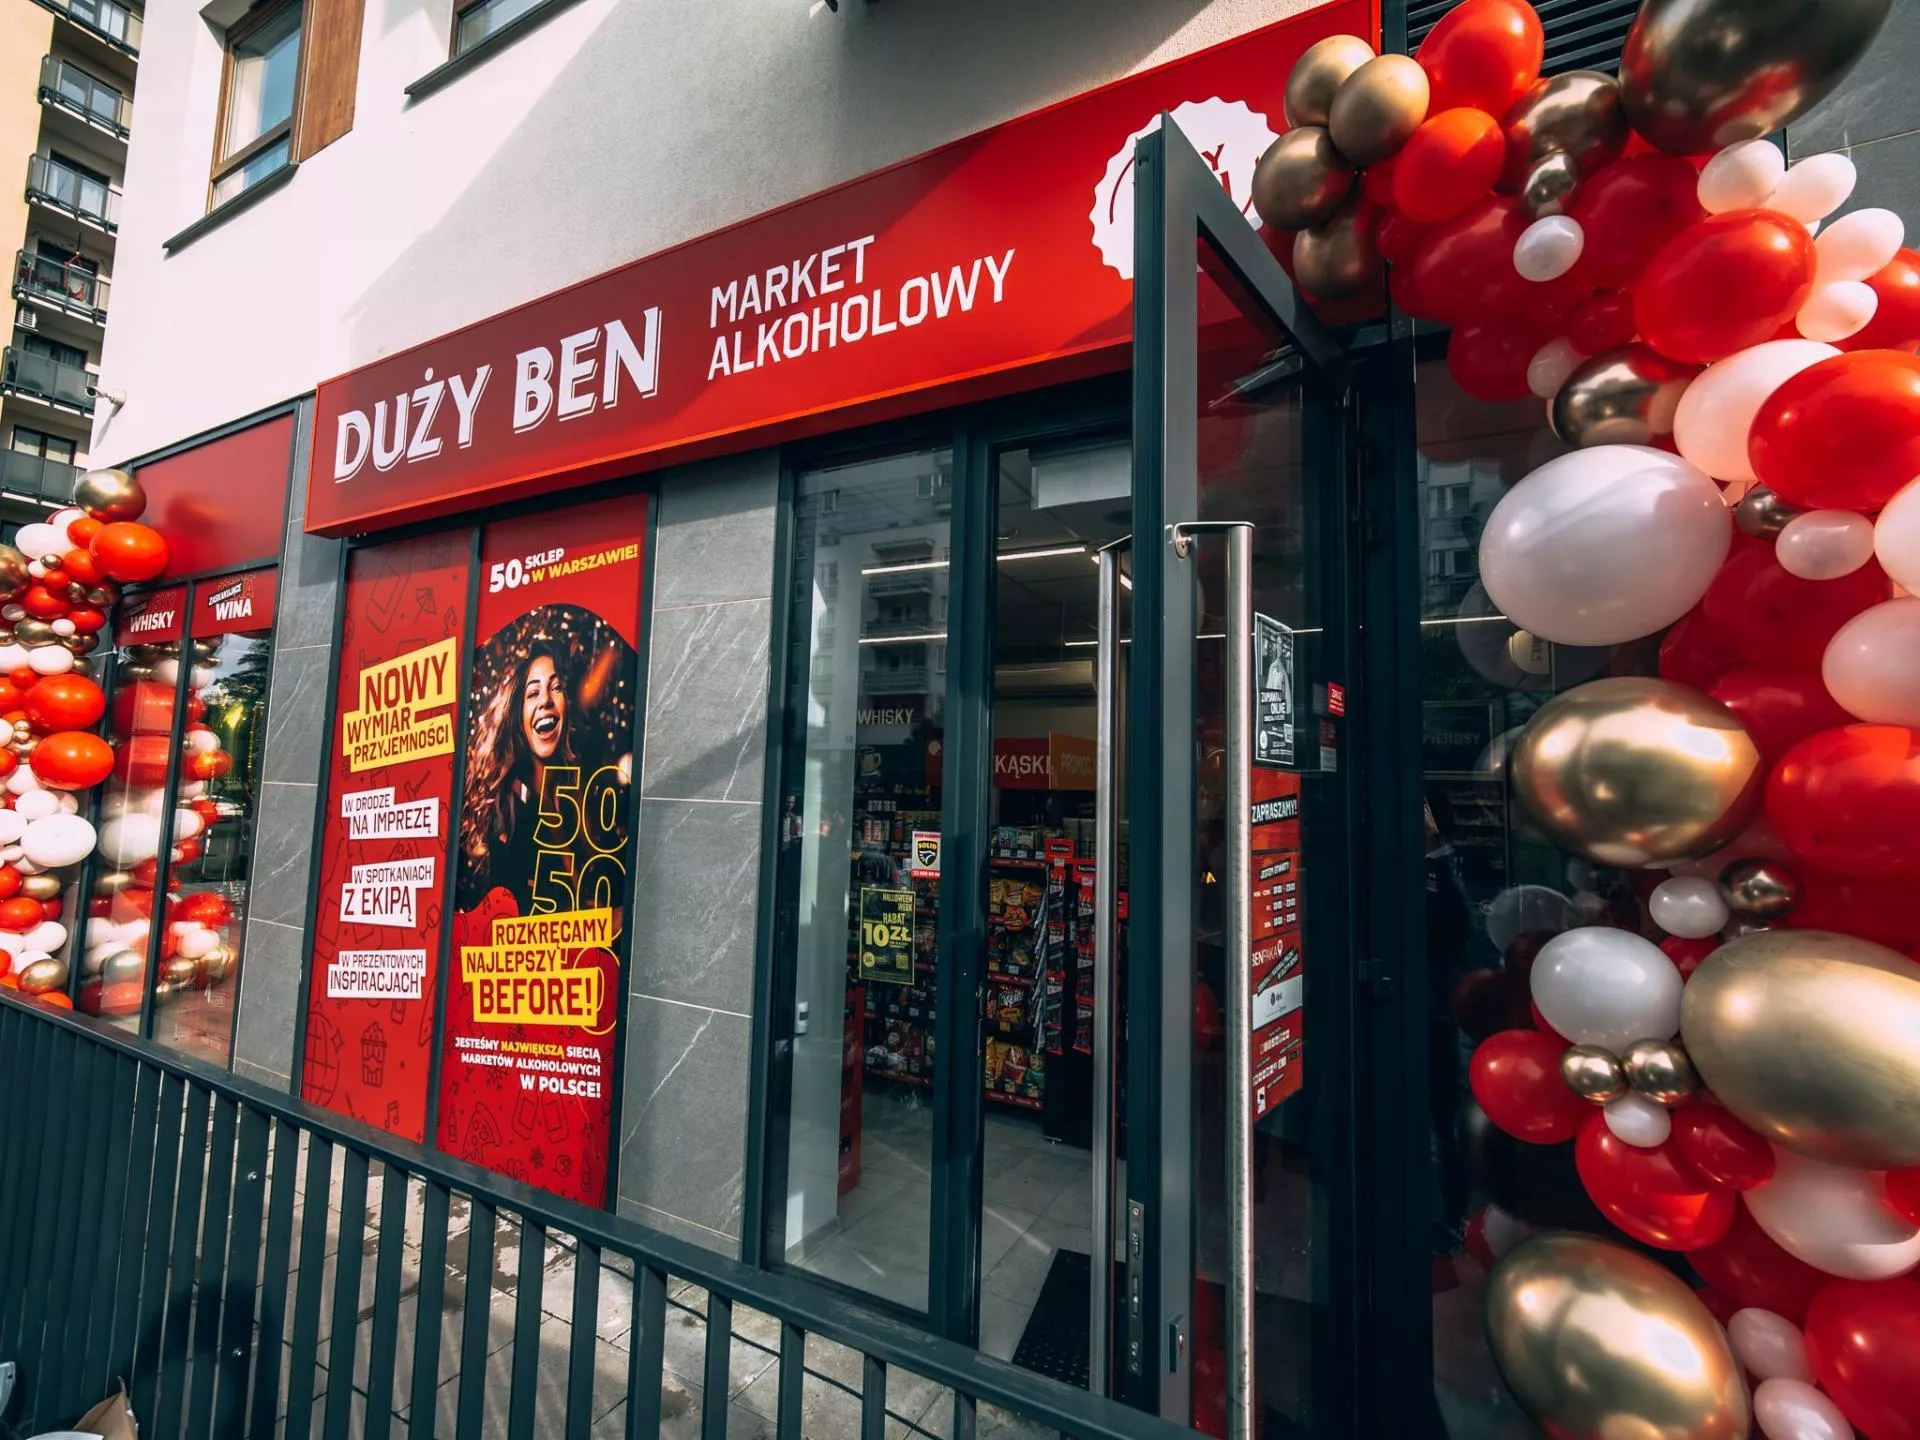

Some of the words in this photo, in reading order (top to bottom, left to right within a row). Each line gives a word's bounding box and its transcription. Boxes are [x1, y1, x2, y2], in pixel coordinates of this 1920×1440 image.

[709, 235, 875, 327] MARKET
[708, 249, 1014, 380] ALKOHOLOWY
[334, 364, 492, 483] DUŻY
[512, 306, 662, 434] BEN
[525, 547, 565, 570] SKLEP
[532, 568, 546, 583] W
[549, 544, 639, 579] WARSZAWIE!
[489, 559, 530, 593] 50.
[130, 610, 175, 633] WHISKY
[215, 598, 252, 621] WINA
[364, 651, 449, 715] NOWY
[347, 707, 411, 745] WYMIAR
[857, 708, 914, 725] WHISKY
[353, 723, 449, 764] PRZYJEMNOŚCI
[993, 754, 1050, 779] KĄSKI
[345, 797, 354, 813] W
[356, 793, 391, 811] DRODZE
[533, 765, 632, 852] 50
[1251, 799, 1297, 822] ZAPRASZAMY!
[352, 814, 369, 835] NA
[373, 805, 432, 834] IMPREZĘ
[918, 842, 937, 850] SOLID
[354, 870, 364, 884] W
[366, 864, 432, 884] SPOTKANIACH
[345, 888, 355, 916] Z
[362, 886, 412, 922] EKIPĄ
[496, 918, 608, 949] ROZKRĘCAMY
[341, 955, 351, 968] W
[353, 953, 423, 969] PREZENTOWYCH
[466, 949, 556, 973] NAJLEPSZY
[330, 972, 419, 993] INSPIRACJACH
[479, 978, 592, 1016] BEFORE!
[455, 1036, 499, 1051] JESTEŚMY
[501, 1041, 565, 1058] NAJWIĘKSZĄ
[567, 1046, 601, 1063] SIECIĄ
[461, 1052, 513, 1068] MARKETÓW
[516, 1057, 601, 1077] ALKOHOLOWYCH
[520, 1075, 535, 1090] W
[539, 1077, 601, 1098] POLSCE!
